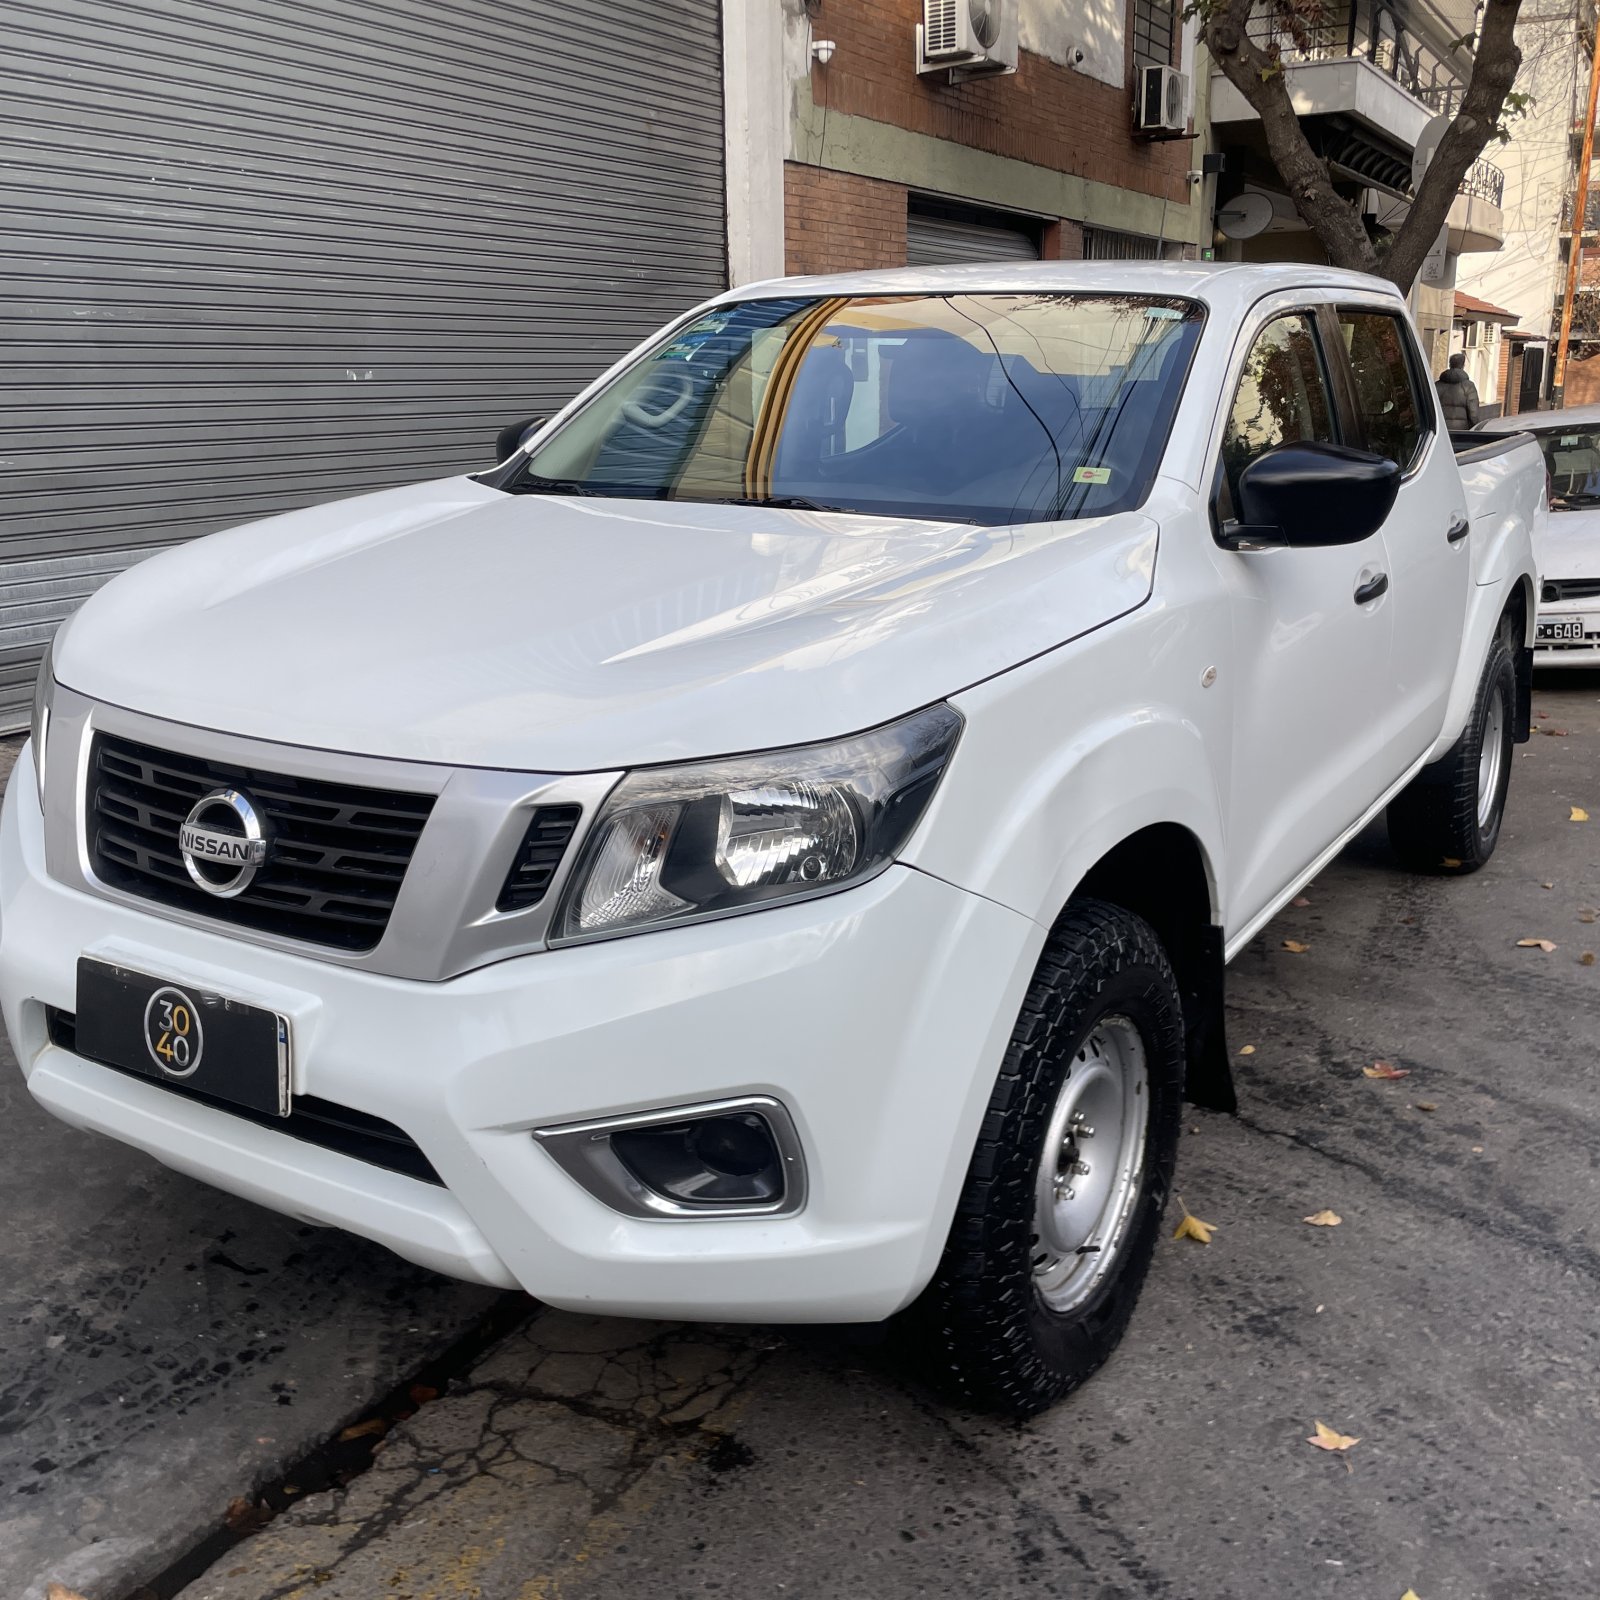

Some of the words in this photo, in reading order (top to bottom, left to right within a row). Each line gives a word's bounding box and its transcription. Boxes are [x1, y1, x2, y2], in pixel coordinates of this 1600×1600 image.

[1554, 624, 1581, 638] 648
[181, 831, 249, 860] NISSAN
[159, 1000, 190, 1036] 30
[156, 1031, 190, 1067] 40
